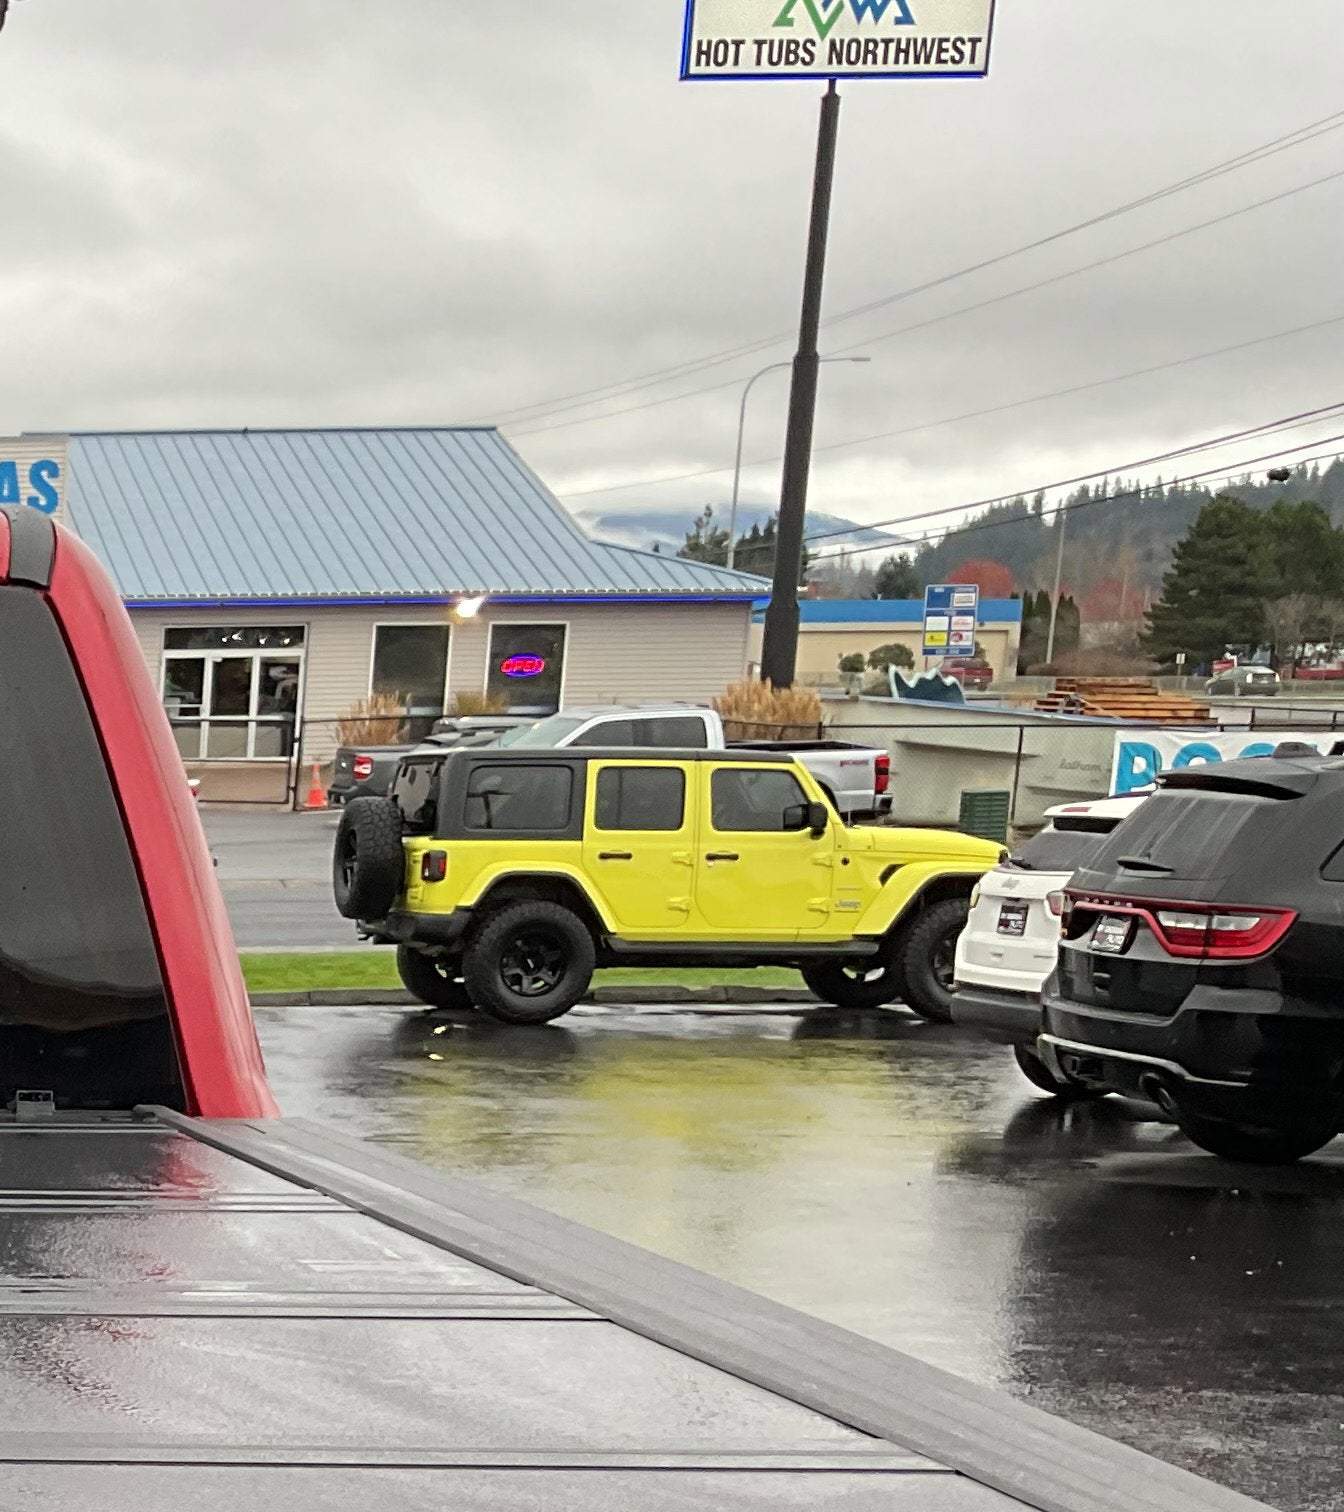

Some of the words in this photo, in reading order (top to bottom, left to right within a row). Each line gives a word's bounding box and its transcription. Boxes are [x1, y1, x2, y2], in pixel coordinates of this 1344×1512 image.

[695, 39, 745, 67] HOT
[752, 38, 816, 67] TUBS
[826, 36, 982, 66] NORTHWEST
[500, 659, 545, 672] OPEN
